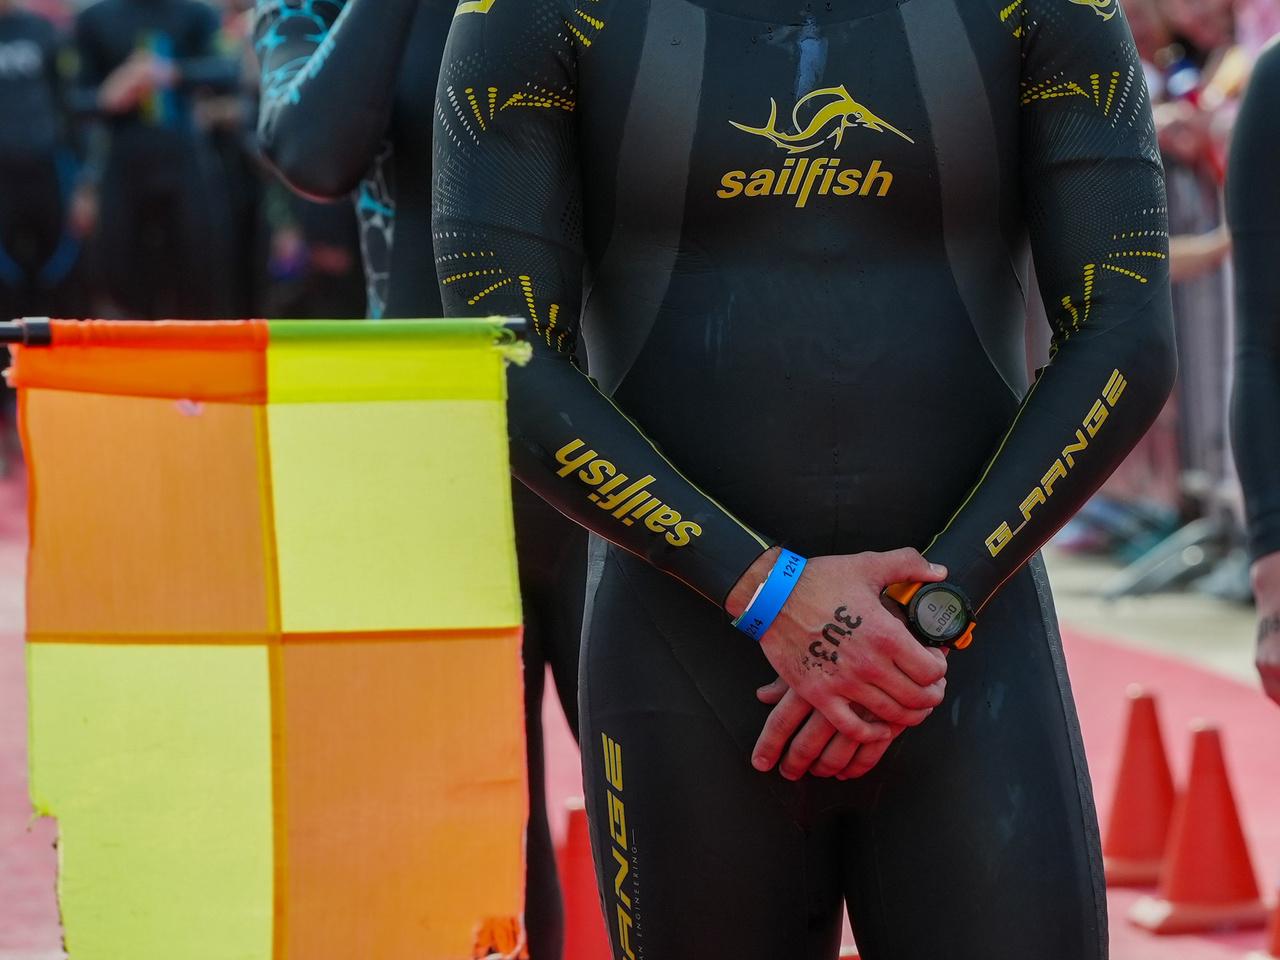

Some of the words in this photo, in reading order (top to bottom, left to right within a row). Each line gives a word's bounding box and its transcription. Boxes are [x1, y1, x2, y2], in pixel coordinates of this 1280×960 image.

[716, 158, 893, 207] sailfish
[555, 439, 702, 547] sailfish
[783, 555, 800, 578] 1214
[602, 732, 636, 960] ANGE
